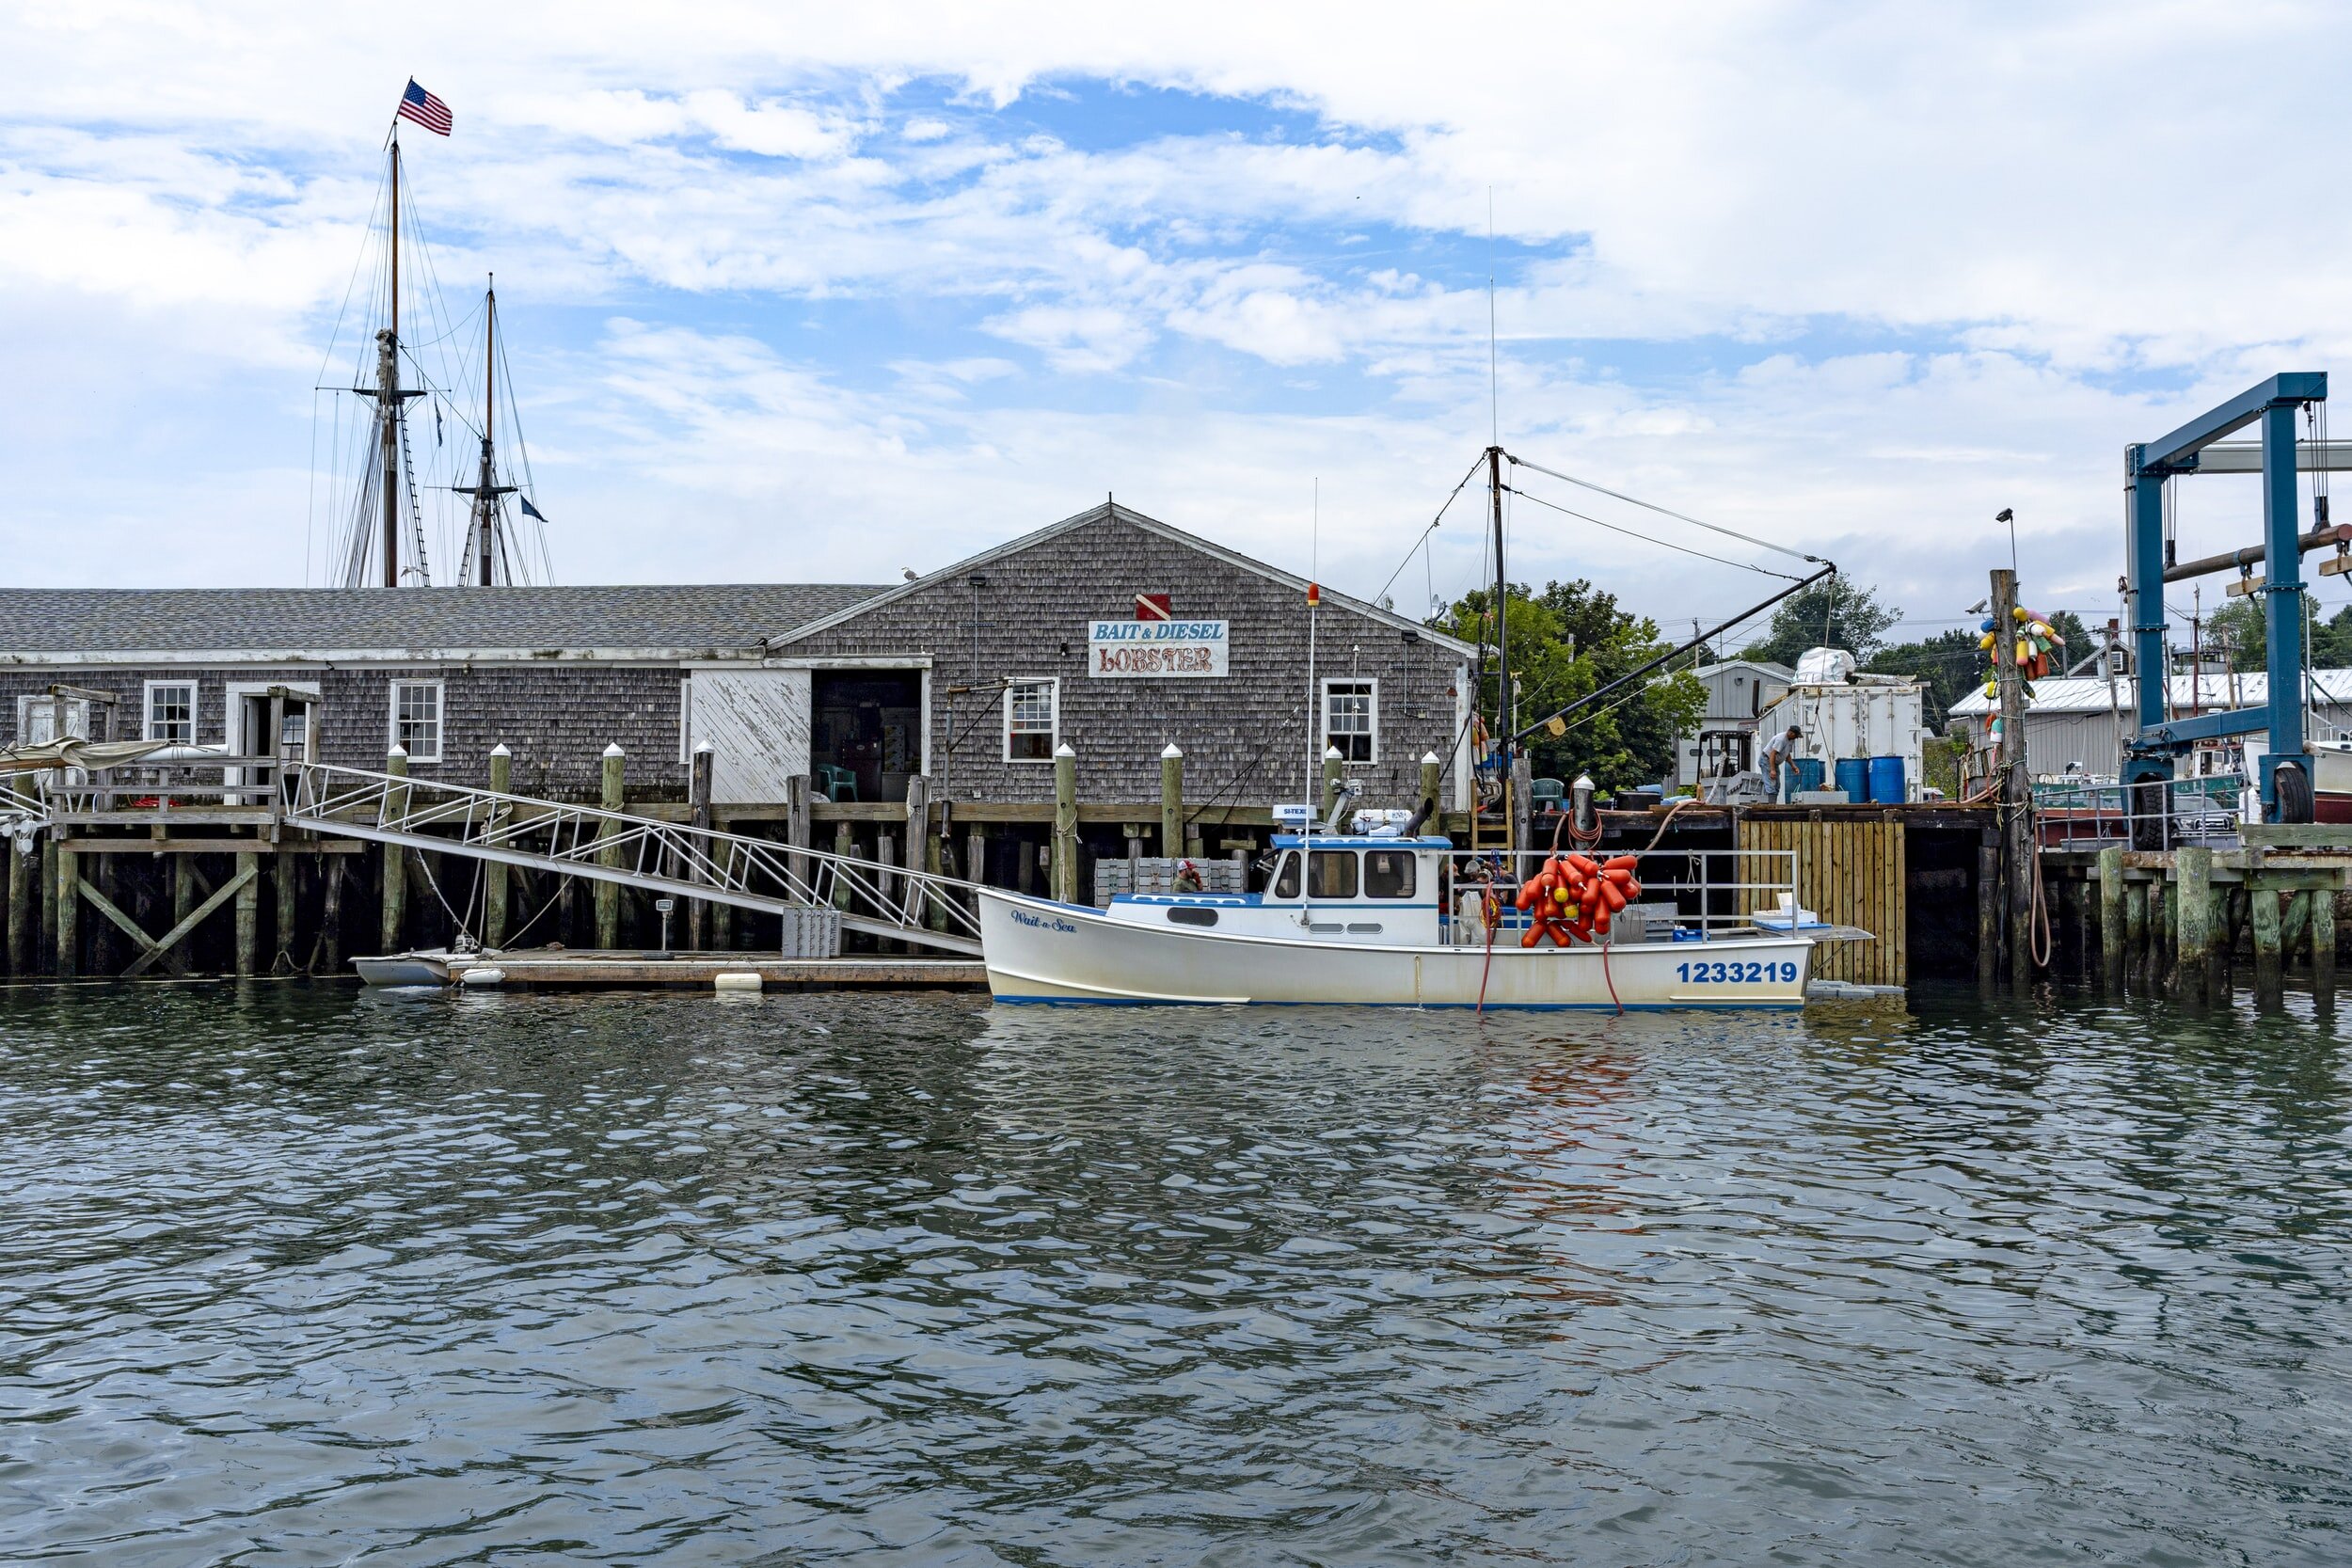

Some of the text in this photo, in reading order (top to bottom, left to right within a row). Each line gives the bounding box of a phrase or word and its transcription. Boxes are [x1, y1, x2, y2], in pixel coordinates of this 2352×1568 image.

[1094, 623, 1223, 640] BAIT & DIESEL
[1099, 647, 1213, 673] LOBSTER
[1677, 962, 1797, 983] 1233219
